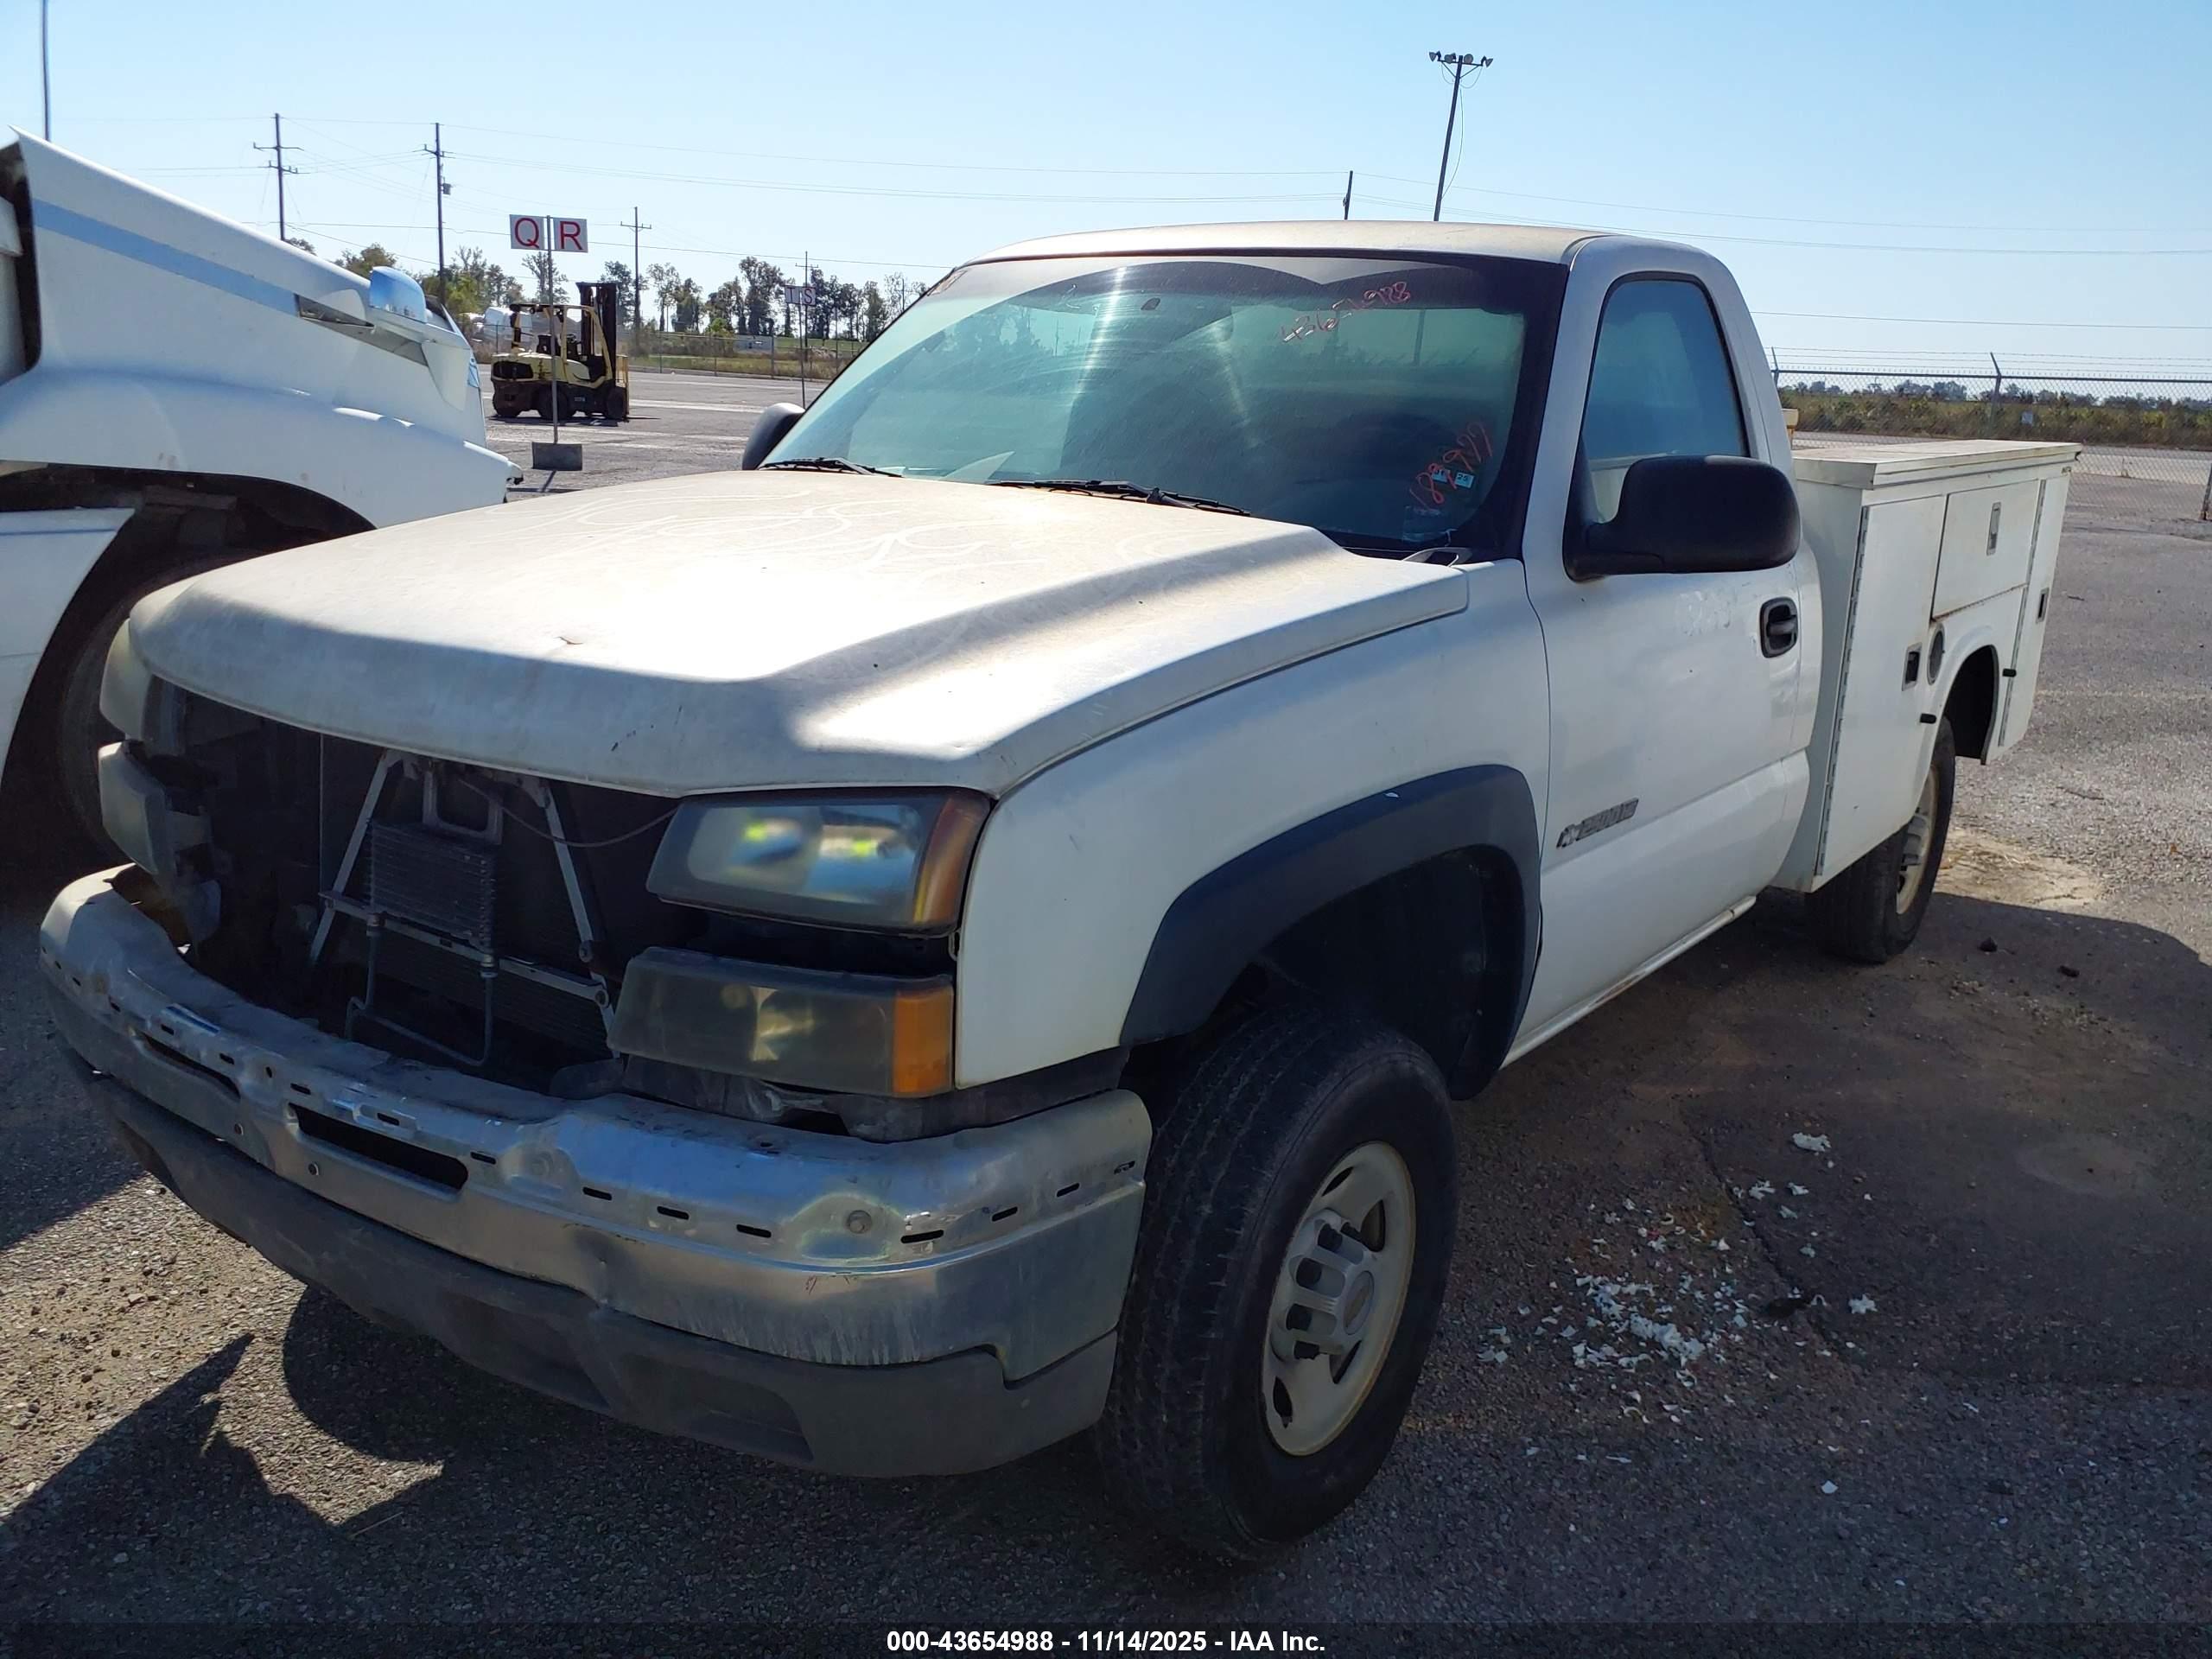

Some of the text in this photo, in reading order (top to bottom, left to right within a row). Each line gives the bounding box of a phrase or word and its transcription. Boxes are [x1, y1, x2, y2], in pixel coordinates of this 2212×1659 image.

[514, 218, 540, 249] Q
[559, 220, 584, 251] R
[804, 288, 813, 304] S
